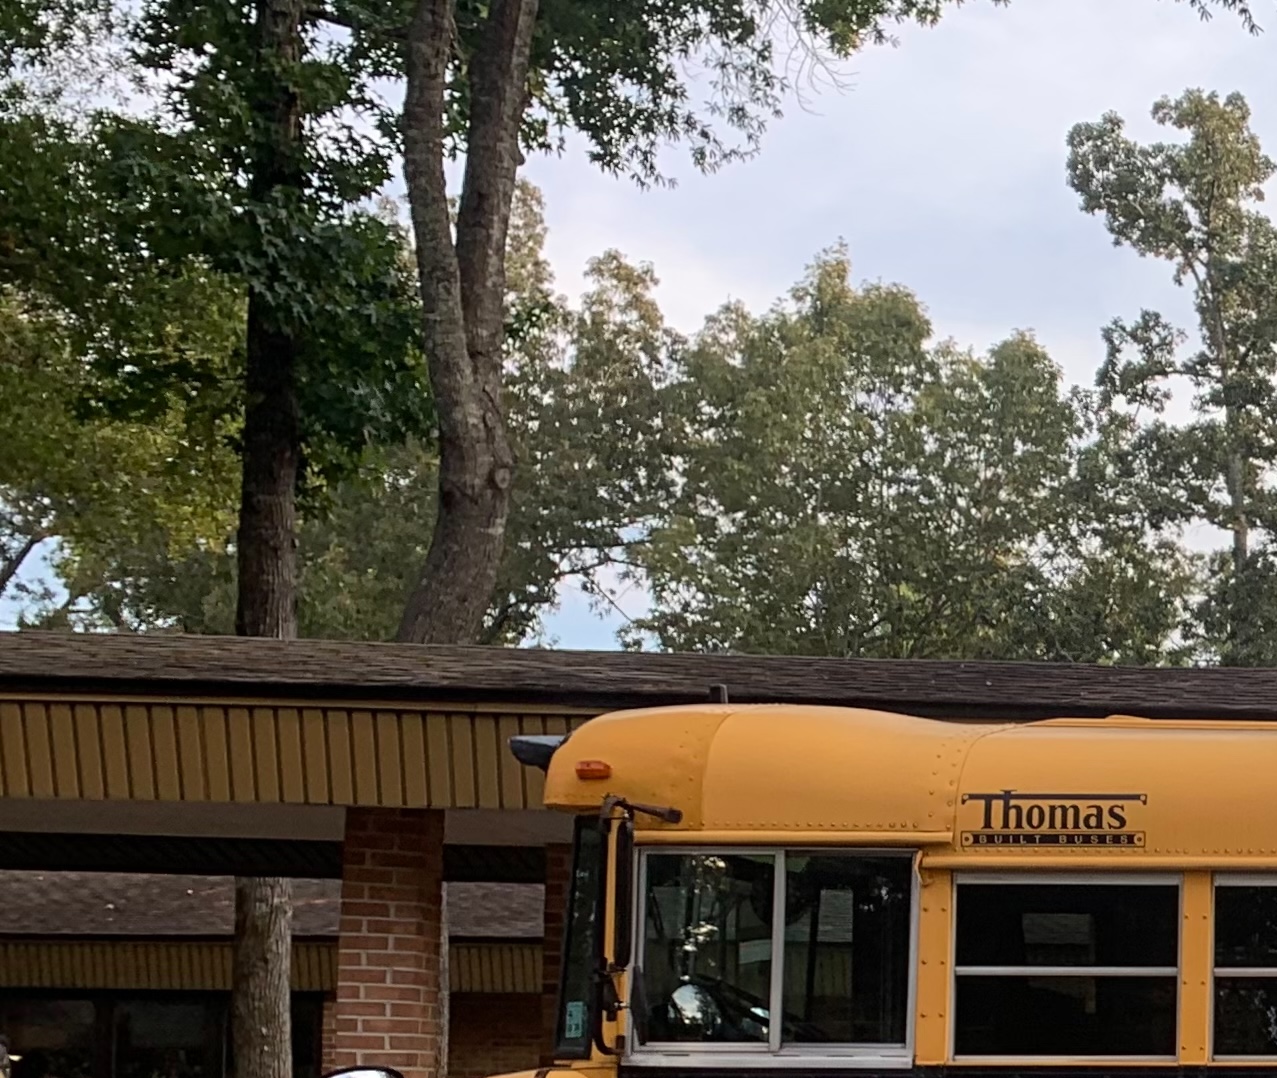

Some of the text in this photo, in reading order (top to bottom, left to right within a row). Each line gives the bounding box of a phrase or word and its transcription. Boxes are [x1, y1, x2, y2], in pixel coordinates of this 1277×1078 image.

[979, 789, 1128, 830] Thomas
[978, 834, 1129, 845] BUILT BUSES
